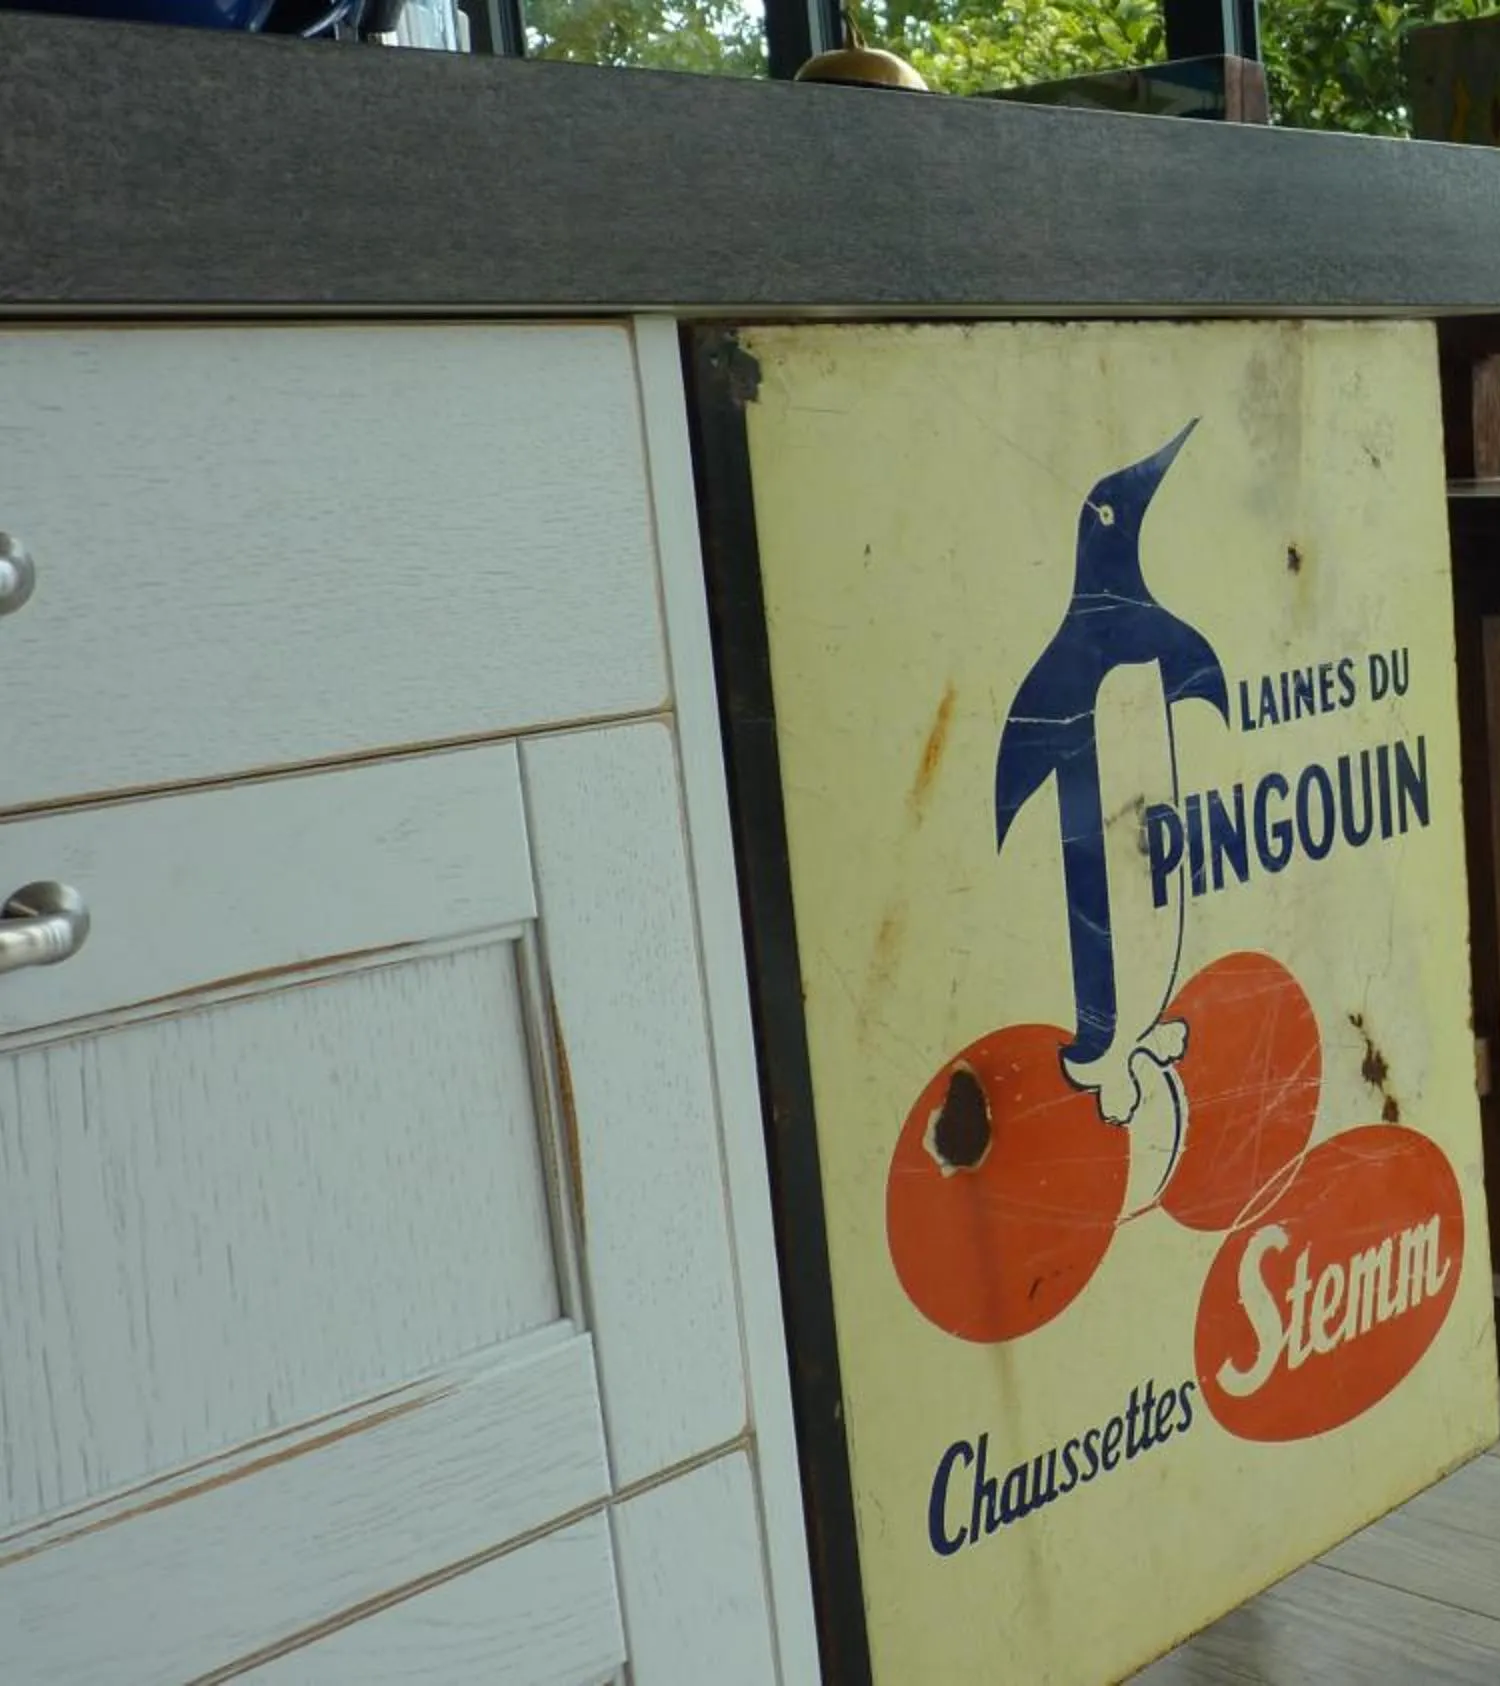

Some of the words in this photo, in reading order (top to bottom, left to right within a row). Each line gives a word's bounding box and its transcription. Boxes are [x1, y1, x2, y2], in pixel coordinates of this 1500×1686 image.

[1239, 657, 1357, 732] LAINES
[1369, 647, 1410, 702] DU
[1146, 735, 1430, 909] PINGOUIN
[928, 1378, 1197, 1557] Chaussettes
[1216, 1213, 1450, 1397] Stemm
